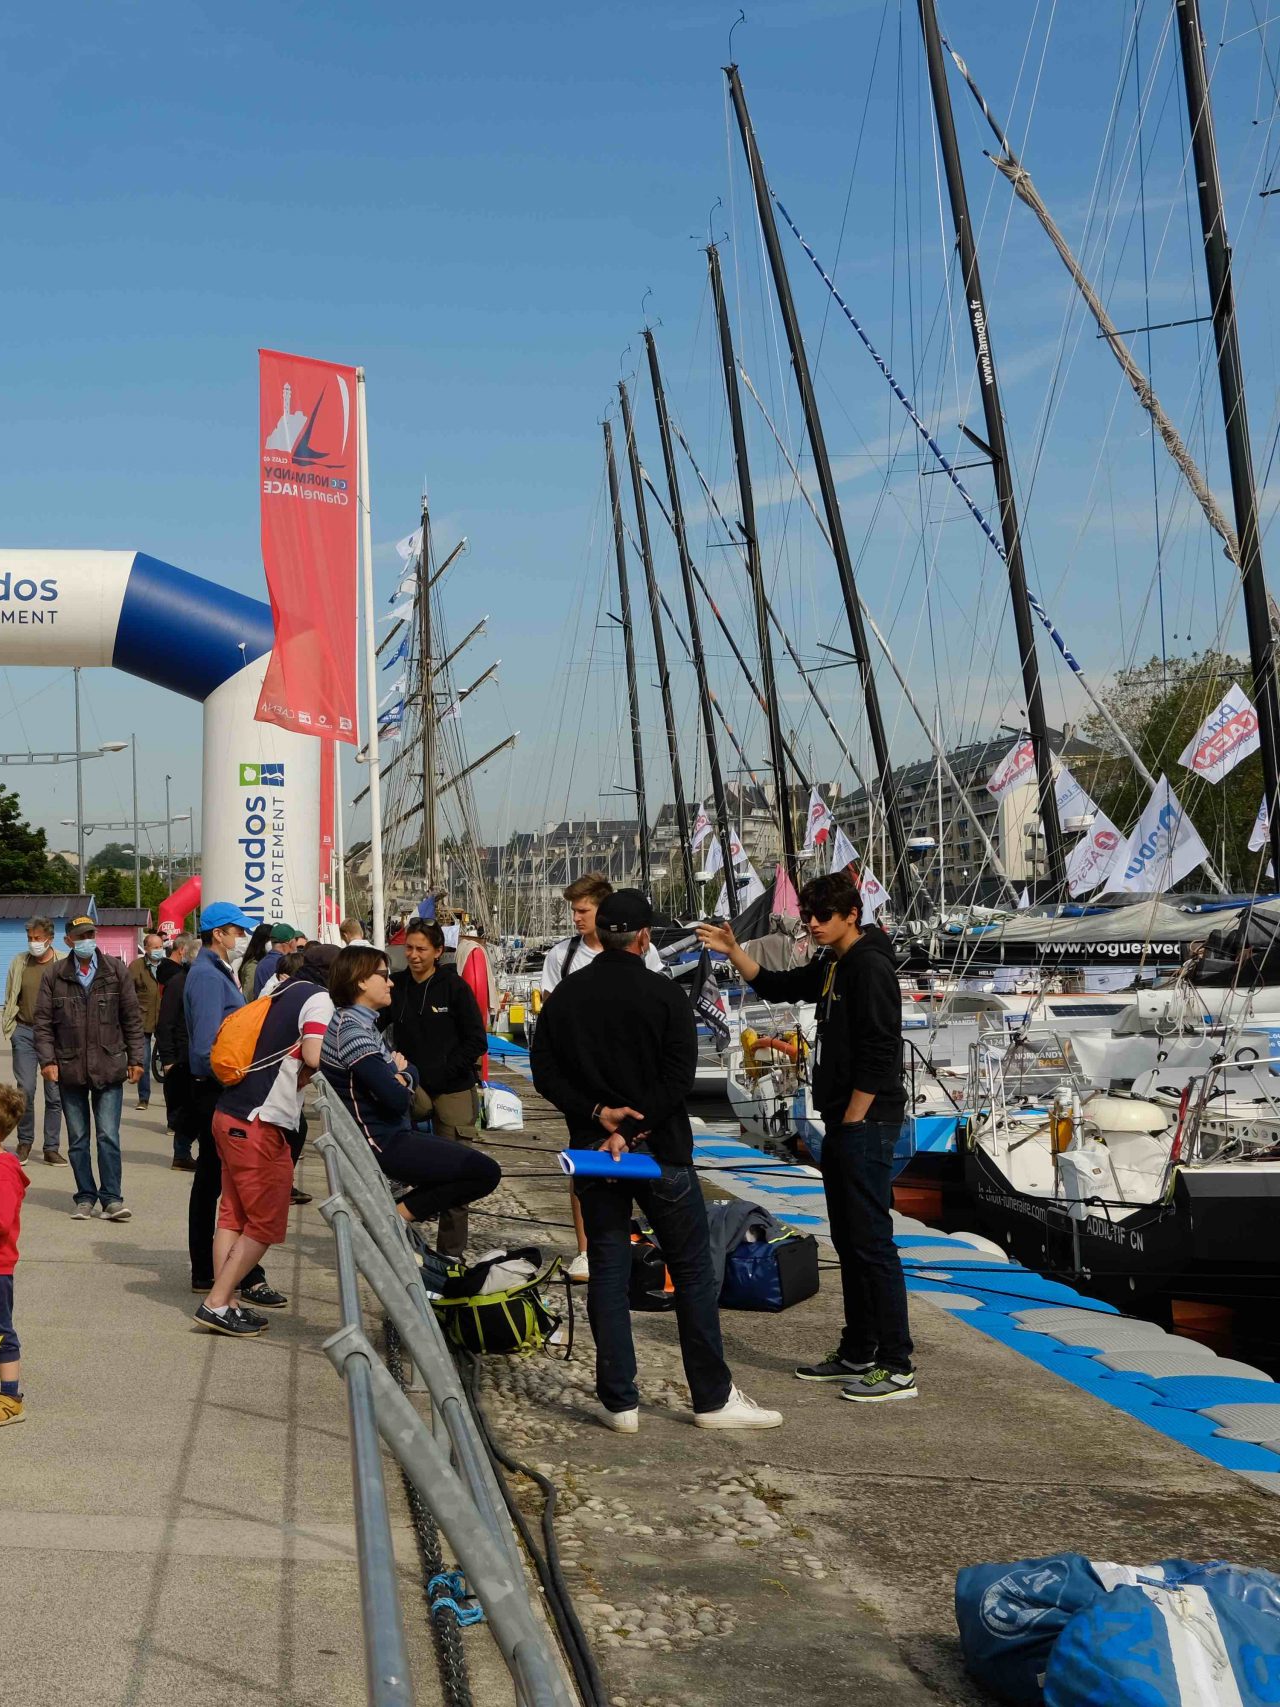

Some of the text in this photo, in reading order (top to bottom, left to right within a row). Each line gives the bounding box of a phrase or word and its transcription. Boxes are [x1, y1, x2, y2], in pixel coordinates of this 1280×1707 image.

[970, 299, 994, 385] www.lamotte.fr
[1015, 1050, 1064, 1060] NORMANDY
[1038, 1059, 1065, 1067] RACE
[1086, 1217, 1144, 1252] ADDICTIF CN
